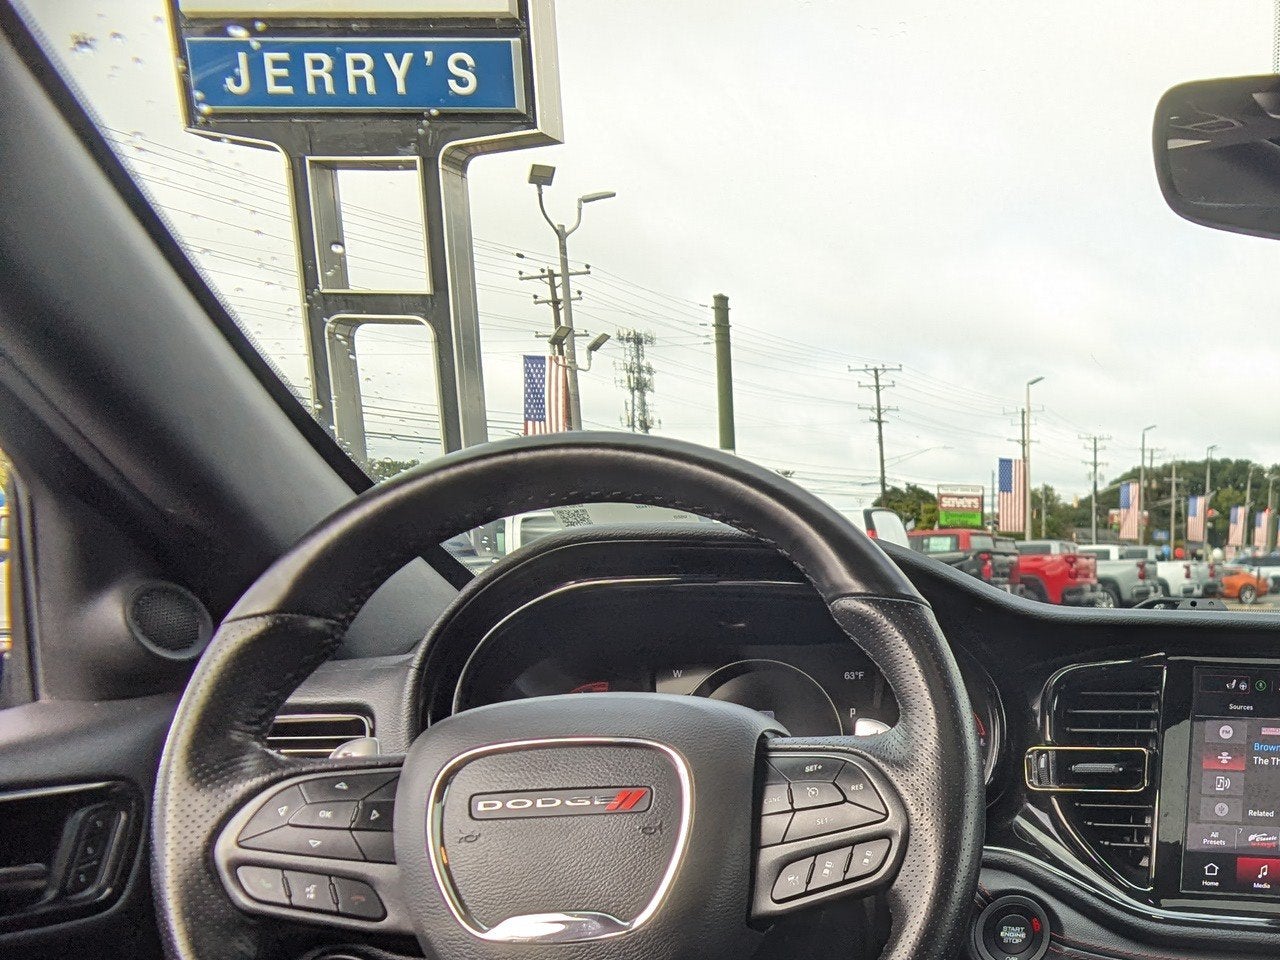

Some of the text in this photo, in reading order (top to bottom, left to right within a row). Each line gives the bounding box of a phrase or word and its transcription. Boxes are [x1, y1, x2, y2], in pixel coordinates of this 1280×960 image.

[225, 51, 478, 96] JERRY'S
[673, 669, 682, 679] W
[844, 671, 864, 680] 63°F
[1229, 703, 1253, 711] Sources
[1253, 756, 1269, 765] The
[477, 795, 620, 811] DODGE
[319, 810, 333, 819] OK
[1248, 809, 1274, 817] Related
[1000, 931, 1027, 939] ENGINE
